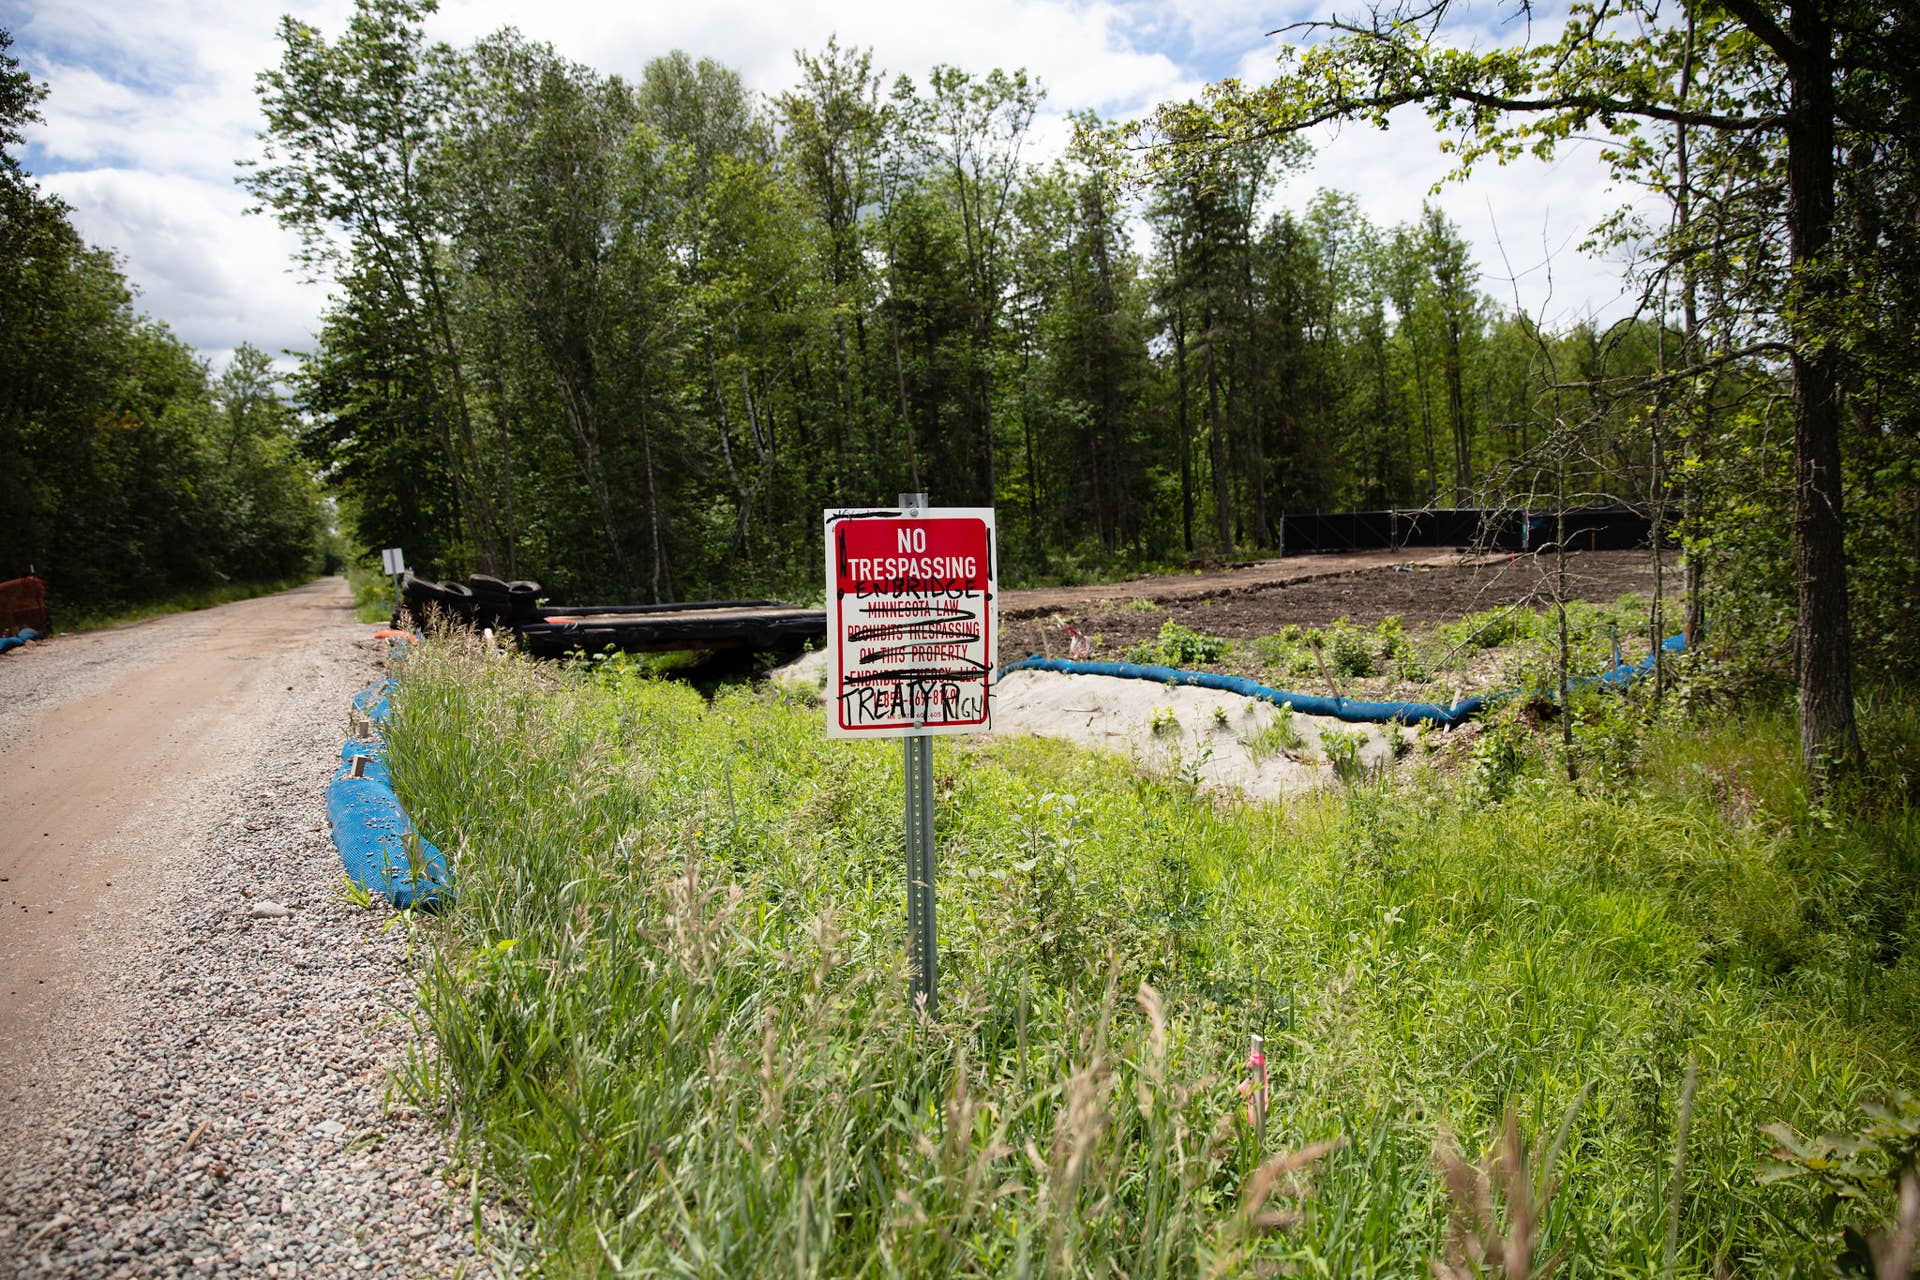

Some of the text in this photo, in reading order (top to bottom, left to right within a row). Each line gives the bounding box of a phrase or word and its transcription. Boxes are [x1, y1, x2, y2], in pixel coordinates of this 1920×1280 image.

[897, 527, 927, 554] NO
[847, 556, 977, 582] TRESPASSING
[855, 576, 980, 599] ENBRIDGE
[868, 599, 959, 618] MINNESOTA LAW
[909, 620, 980, 640] TRESPASSING
[859, 643, 969, 664] ON THIS PROPERTY
[910, 666, 953, 684] ERGY
[836, 681, 937, 726] TREATY
